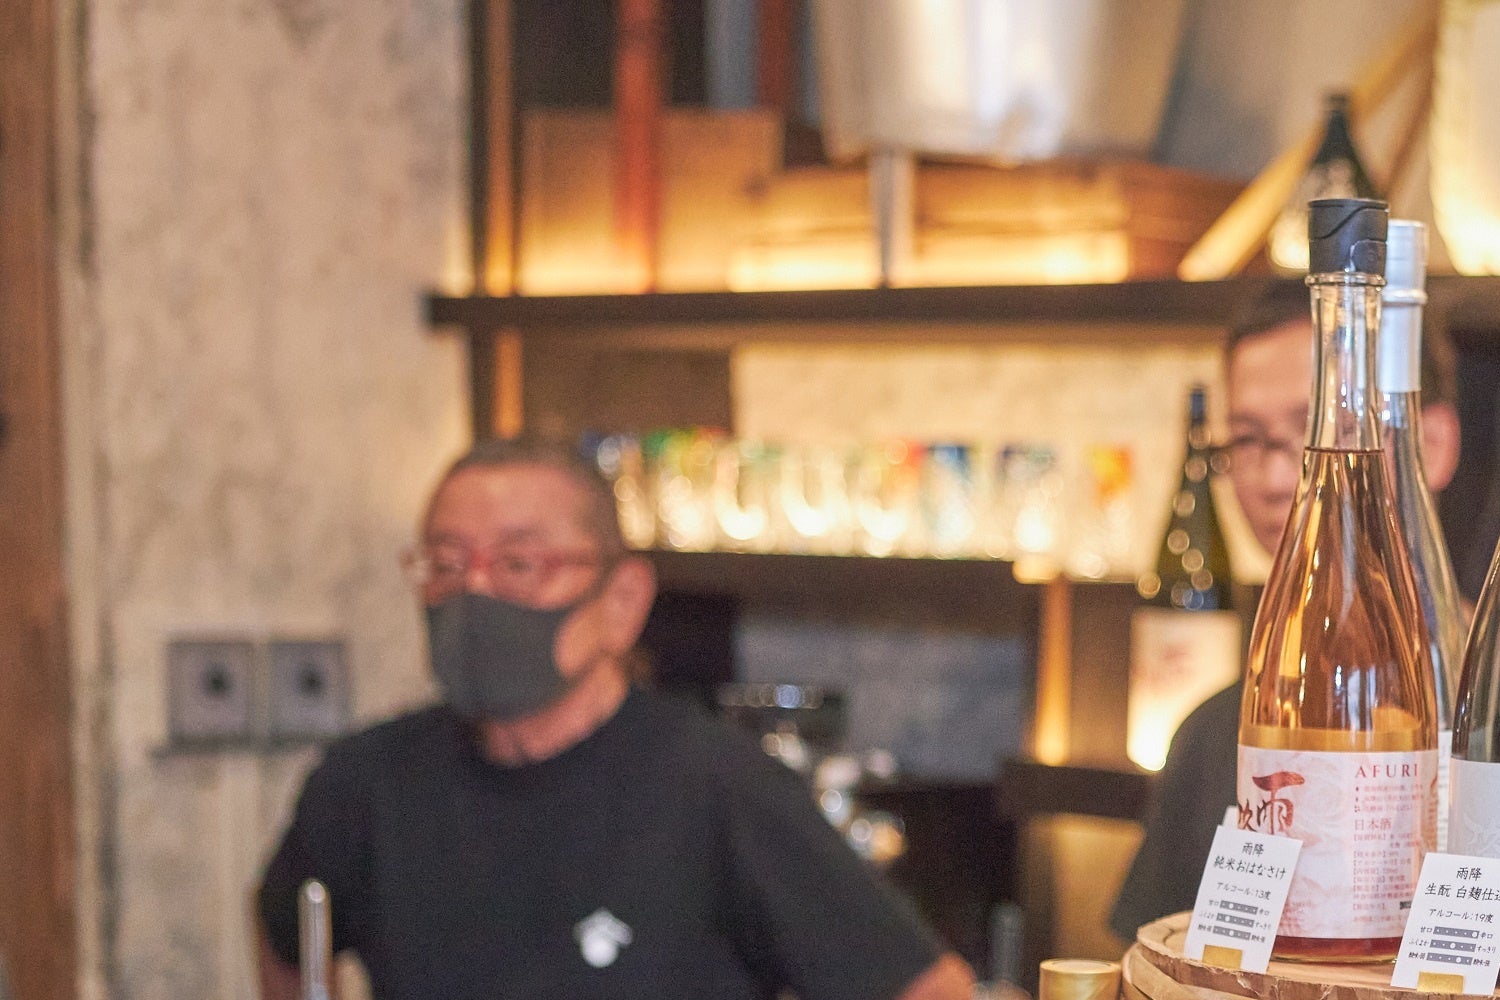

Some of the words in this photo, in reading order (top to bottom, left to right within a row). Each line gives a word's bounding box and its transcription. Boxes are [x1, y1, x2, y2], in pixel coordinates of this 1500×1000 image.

[1354, 763, 1418, 779] AFURI
[1213, 855, 1287, 880] 純米おはなさけ
[1456, 867, 1482, 881] 雨降
